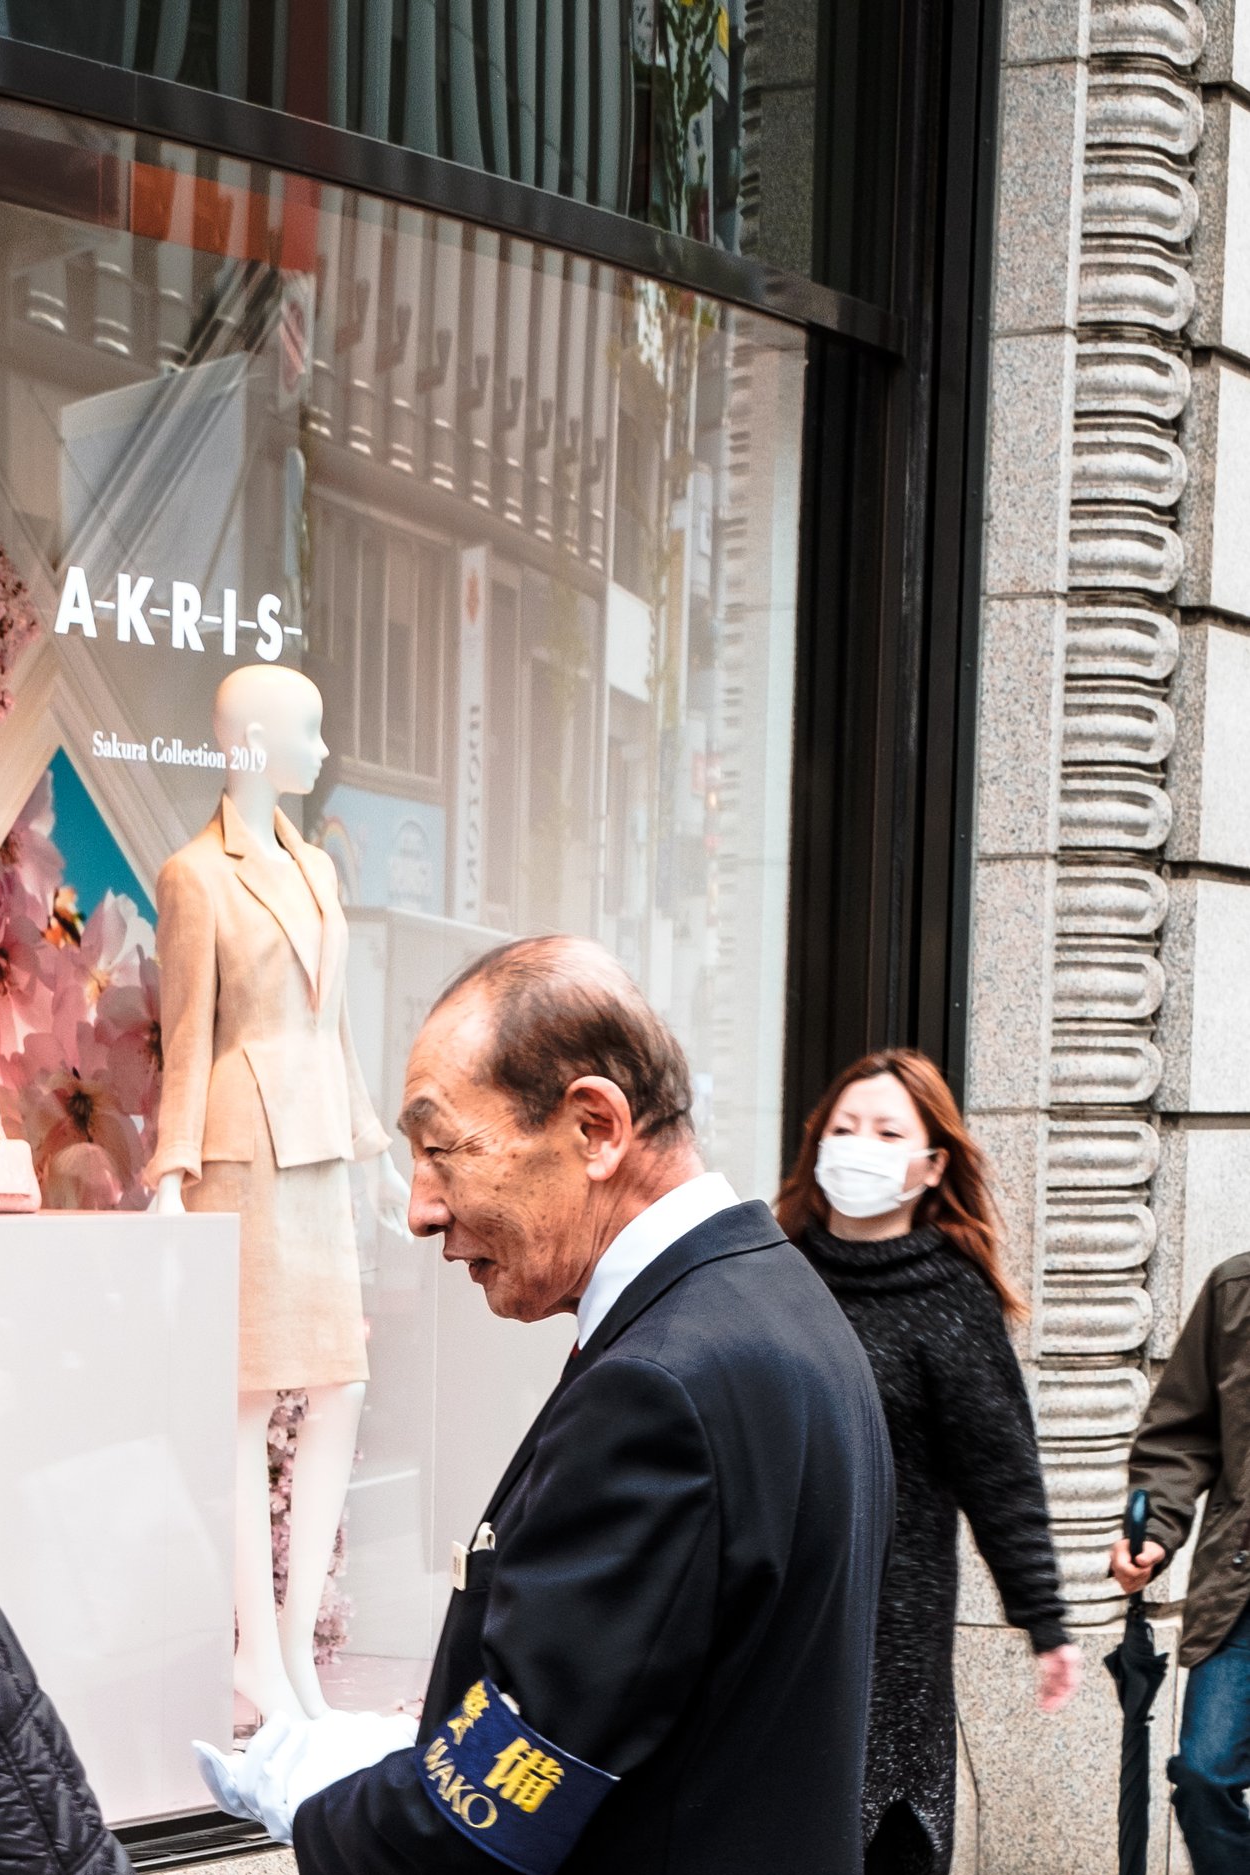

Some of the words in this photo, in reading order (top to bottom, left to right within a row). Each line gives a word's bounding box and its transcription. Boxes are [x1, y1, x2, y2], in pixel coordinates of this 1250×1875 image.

[92, 731, 147, 761] Sakura
[151, 737, 226, 769] Collection
[230, 745, 267, 773] 2019
[423, 1737, 498, 1829] WAKO
